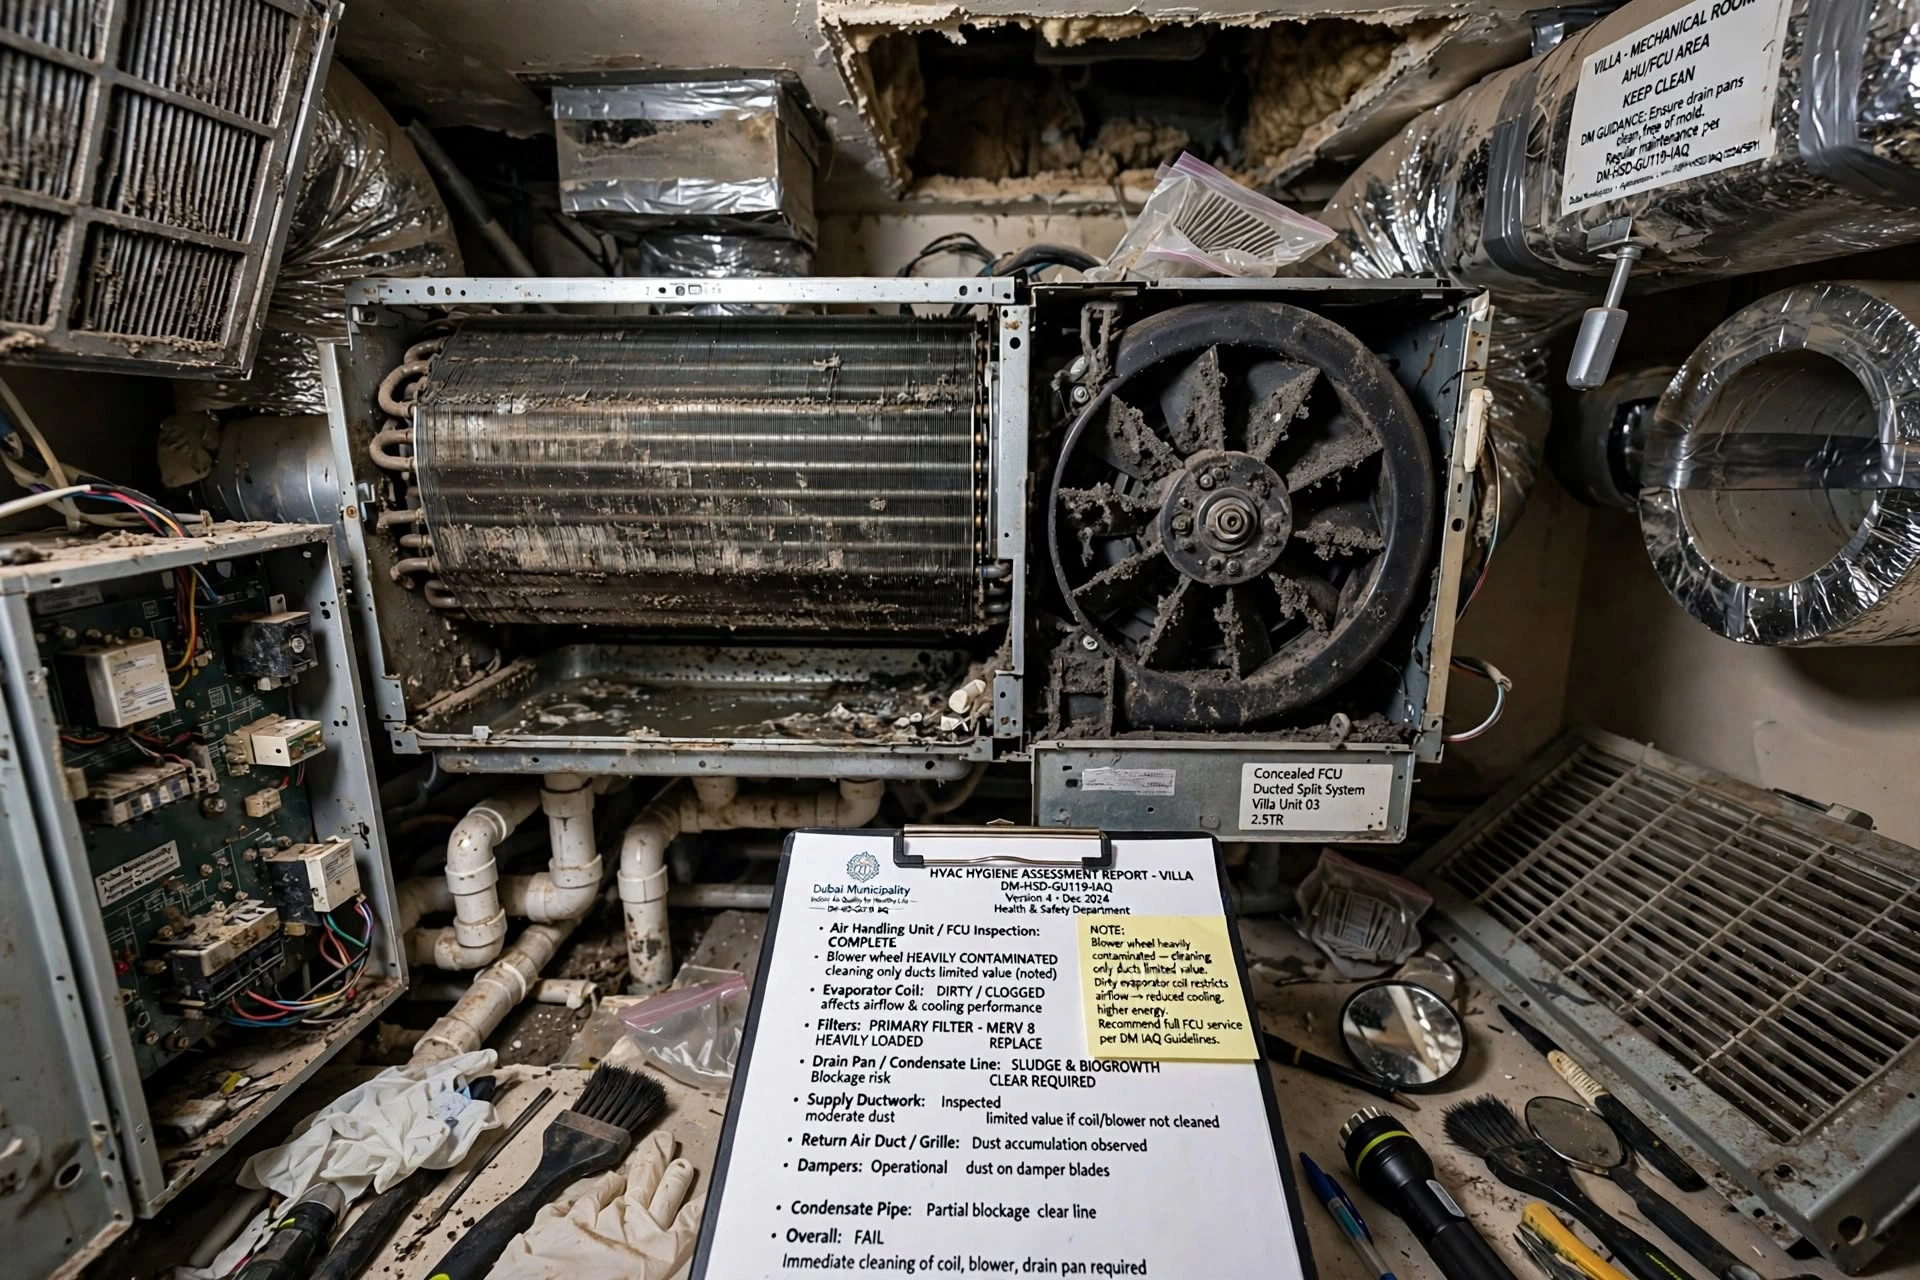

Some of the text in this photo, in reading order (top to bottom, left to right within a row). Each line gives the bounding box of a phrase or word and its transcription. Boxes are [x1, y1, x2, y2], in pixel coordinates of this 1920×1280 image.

[1594, 51, 1621, 75] VILLA
[1630, 10, 1707, 58] MECHANICAL
[1622, 34, 1710, 85] AHU/FCU AREA
[1622, 66, 1696, 108] KEEP CLEAN
[1581, 76, 1744, 146] DM GUIDANCE: Ensure drain pans
[1664, 115, 1675, 129] of
[1676, 104, 1704, 125] mold.
[1702, 118, 1721, 137] per
[1254, 768, 1342, 780] Concealed FCU
[1253, 783, 1365, 798] Ducted Split System
[1252, 798, 1320, 811] Villa Unit 03
[1251, 814, 1284, 826] 2.5TR
[930, 868, 1193, 881] HVAC HYGIENE ASSESSMENT REPORT VILLA
[813, 884, 911, 897] Dubai Municipality
[1001, 881, 1112, 893] DM-HSD-GU119-IAQ
[1063, 894, 1081, 903] Dec
[994, 904, 1130, 916] Health & Safety Department
[830, 923, 1040, 938] Air Handling Unit FCU Inspection:
[1090, 925, 1125, 935] NOTE:
[828, 937, 897, 948] COMPLETE
[1092, 938, 1124, 947] Blower
[1158, 939, 1191, 950] heavily
[827, 951, 1058, 965] Blower wheel HEAVILY CONTAMINATED
[825, 965, 1057, 981] cleaning only ducts limited value (noted)
[1094, 978, 1117, 989] Dirty
[1172, 979, 1187, 988] coil
[1191, 979, 1228, 988] restricts
[823, 984, 1045, 999] Evaporator Coil: DIRTY CLOGGED
[1096, 990, 1129, 1001] airflow
[1146, 992, 1184, 1001] reduced
[821, 999, 1042, 1015] affects airflow & cooling performance
[817, 1019, 1035, 1034] Filters: PRIMARY FILTER MERV 8
[1099, 1019, 1243, 1030] Recommend full FCU service
[815, 1035, 1042, 1050] HEAVILY LOADED REPLACE
[1100, 1033, 1220, 1045] per DM IAQ Guidelines.
[812, 1055, 1160, 1073] Drain Pan Condensate Line: SLUDGE & BIOGROWTH
[811, 1071, 1096, 1089] Blockage risk CLEAR REQUIRED
[807, 1093, 1001, 1111] Supply Ductwork: Inspected
[805, 1109, 1220, 1128] moderate dust limited value if coil/blower not cleaned
[801, 1133, 1147, 1151] Return Air Duct Grille: Dust accumulation observed
[798, 1158, 1110, 1179] Dampers: Operational dust on damper blades
[791, 1200, 1097, 1221] Condensate Pipe: Partial blockage clear line
[786, 1228, 884, 1244] Overall: FAIL
[783, 1254, 1146, 1278] Immediate cleaning of coil, blower, drain pan required
